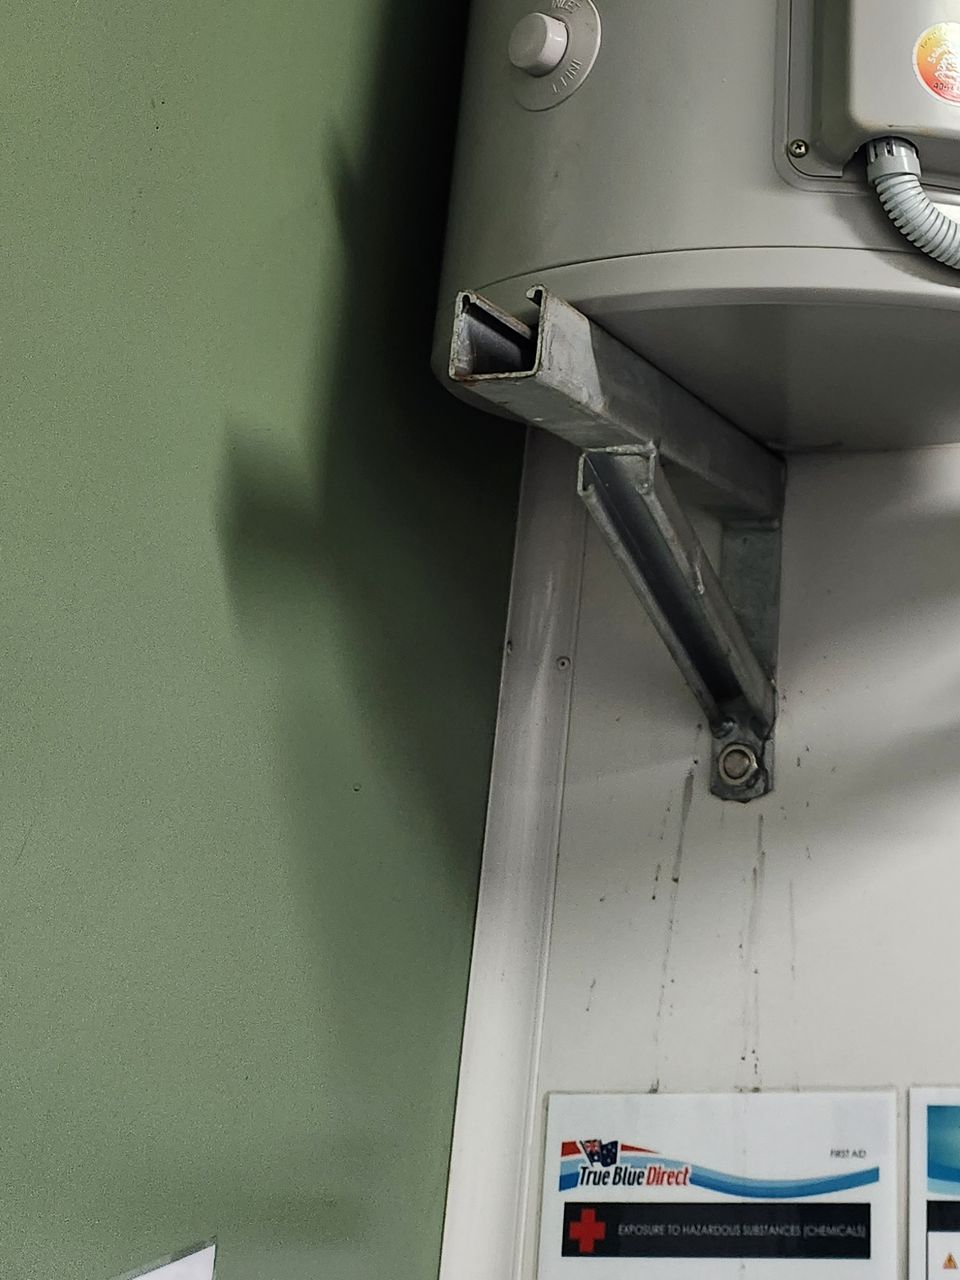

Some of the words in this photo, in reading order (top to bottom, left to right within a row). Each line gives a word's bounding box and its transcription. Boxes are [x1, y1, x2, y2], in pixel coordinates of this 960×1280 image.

[551, 0, 581, 14] INLET
[830, 1148, 849, 1158] FIRST
[851, 1149, 867, 1158] AID
[579, 1166, 610, 1186] True
[612, 1166, 645, 1186] Blue
[646, 1166, 689, 1186] Direct
[618, 1224, 666, 1236] EXPOSURE
[668, 1224, 681, 1236] TO
[682, 1224, 740, 1236] HAZARDOUS
[743, 1224, 800, 1237] SUBSTANCES
